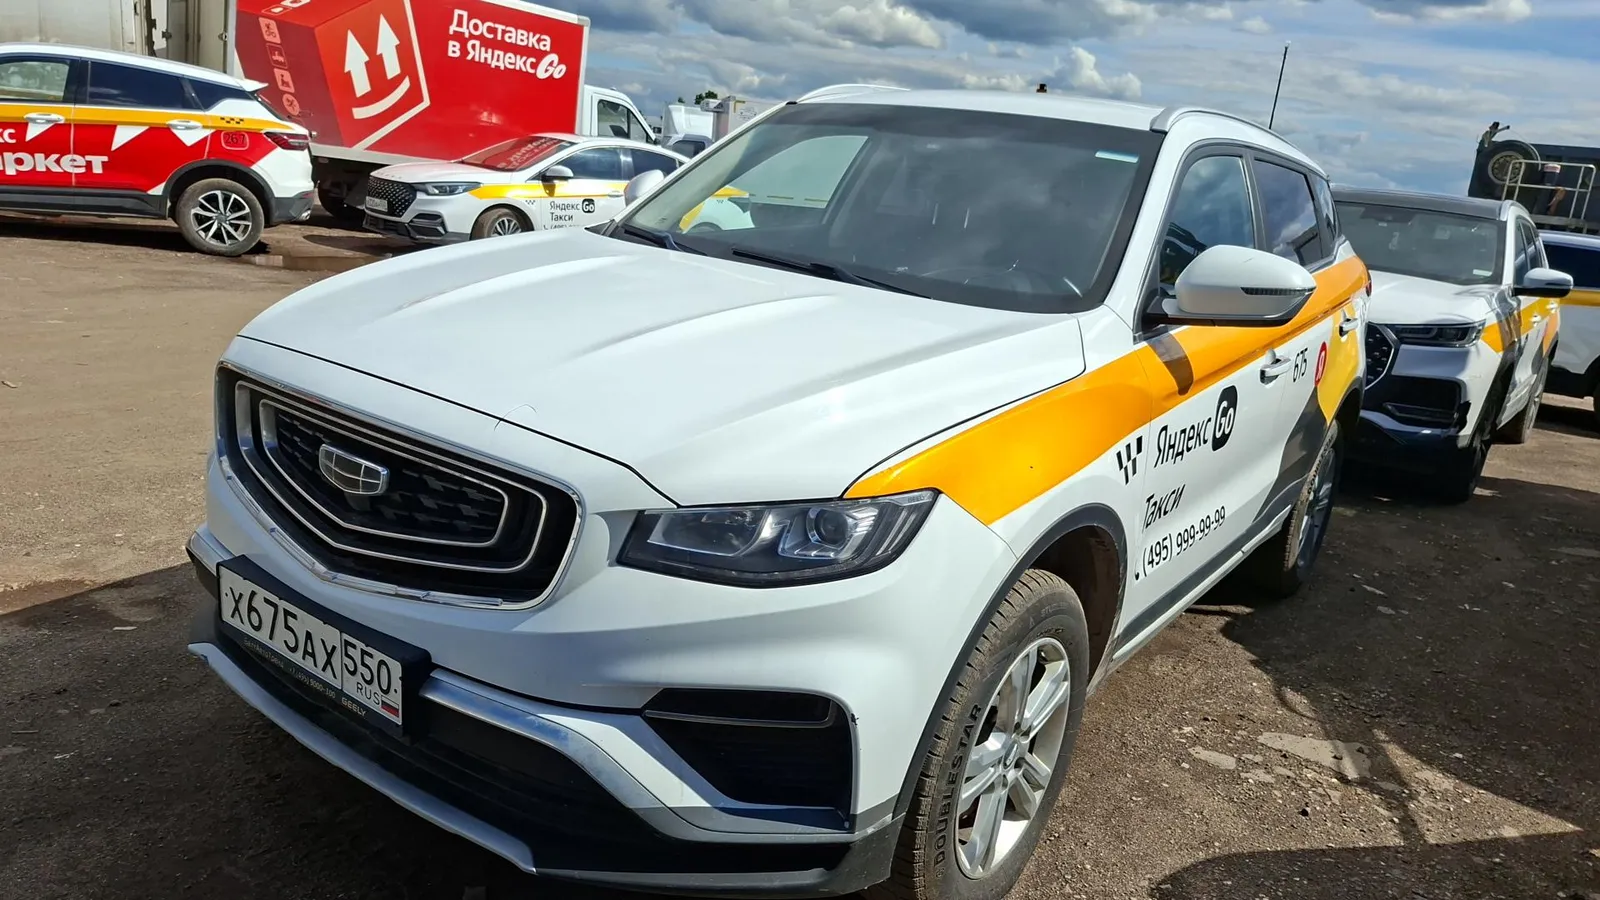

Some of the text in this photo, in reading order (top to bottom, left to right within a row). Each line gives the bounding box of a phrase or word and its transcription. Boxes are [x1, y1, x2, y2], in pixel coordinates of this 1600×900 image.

[449, 9, 551, 51] Доставка
[448, 39, 567, 79] в Яндекс Go
[0, 151, 109, 176] ркет
[549, 200, 595, 212] Яндекс Go
[549, 212, 574, 222] Такси
[1292, 347, 1308, 383] 675
[1153, 397, 1236, 469] Яндекс Go
[1142, 483, 1186, 534] Такси
[1142, 505, 1226, 578] (495) 999-99-99
[343, 638, 392, 695] 550
[341, 696, 368, 717] GEELY
[356, 683, 382, 706] RUS
[934, 703, 982, 868] DOUBLESTAR
